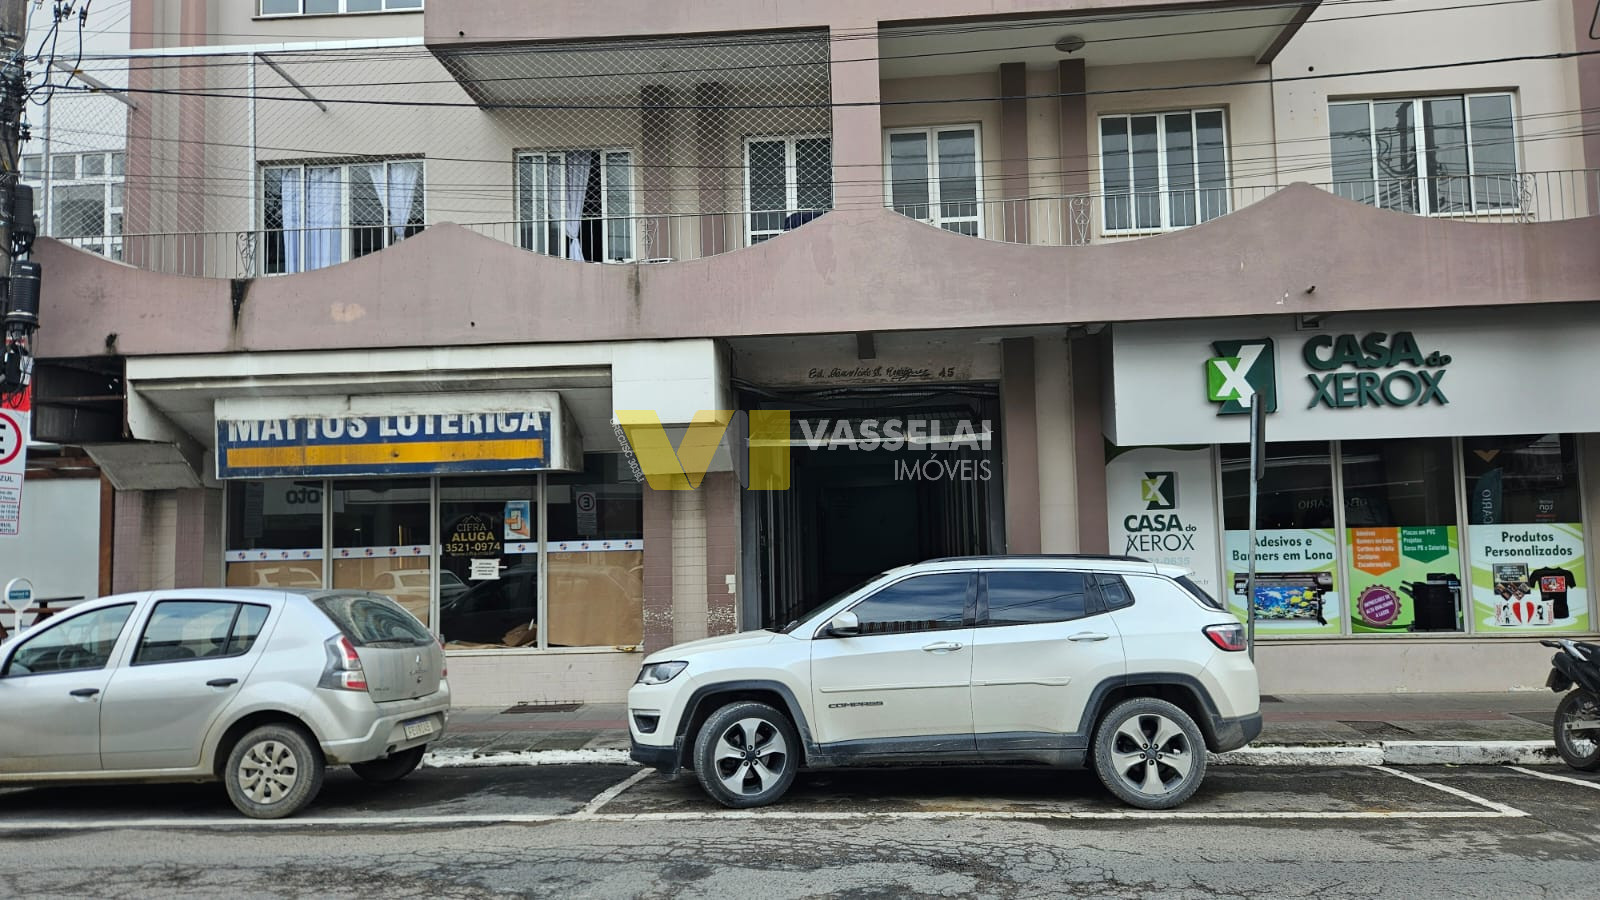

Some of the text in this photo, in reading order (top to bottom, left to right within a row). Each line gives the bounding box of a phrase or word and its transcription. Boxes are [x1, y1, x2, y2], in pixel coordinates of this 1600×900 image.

[1304, 331, 1452, 370] CASA do
[1308, 369, 1450, 410] XEROX
[456, 523, 487, 532] CIFRA
[1124, 514, 1197, 532] CASA do
[451, 531, 495, 542] ALUGA
[1126, 534, 1195, 552] XEROX
[1253, 536, 1313, 547] Adesivos e
[1501, 530, 1554, 543] Produtos
[445, 542, 501, 552] 3521-0974
[1485, 544, 1573, 557] Personalizados
[1283, 552, 1300, 560] em
[1305, 549, 1333, 560] Lona
